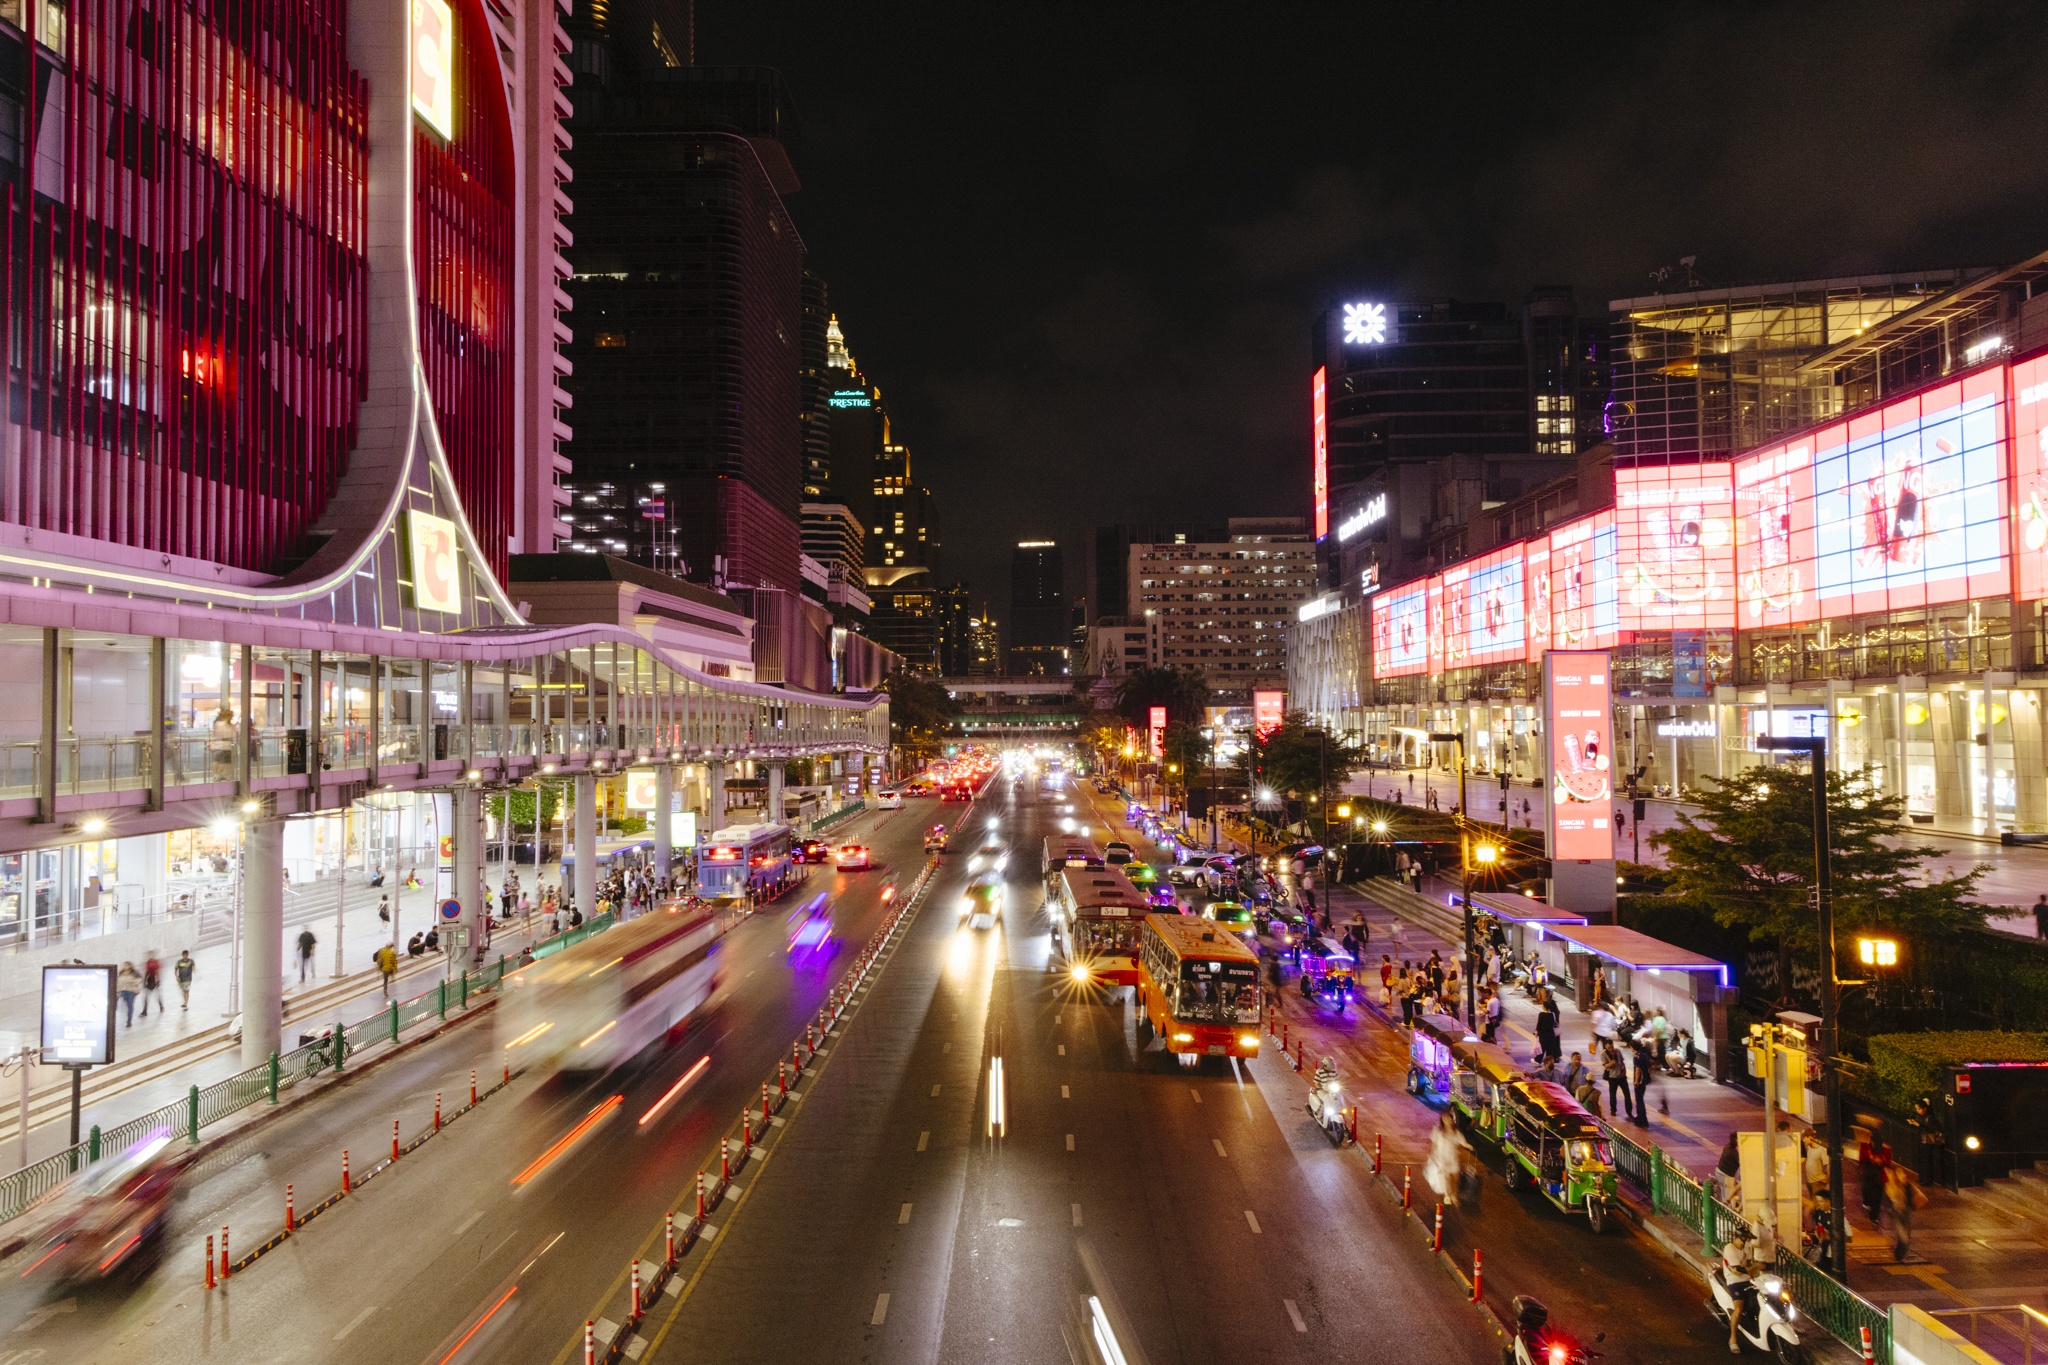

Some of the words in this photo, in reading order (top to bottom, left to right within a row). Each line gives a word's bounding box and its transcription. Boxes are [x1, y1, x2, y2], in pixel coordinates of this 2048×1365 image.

[829, 399, 871, 408] PRESTIGE
[420, 524, 438, 552] Big
[424, 530, 449, 602] C
[1658, 721, 1716, 737] centralwOrld
[1104, 907, 1114, 915] 54
